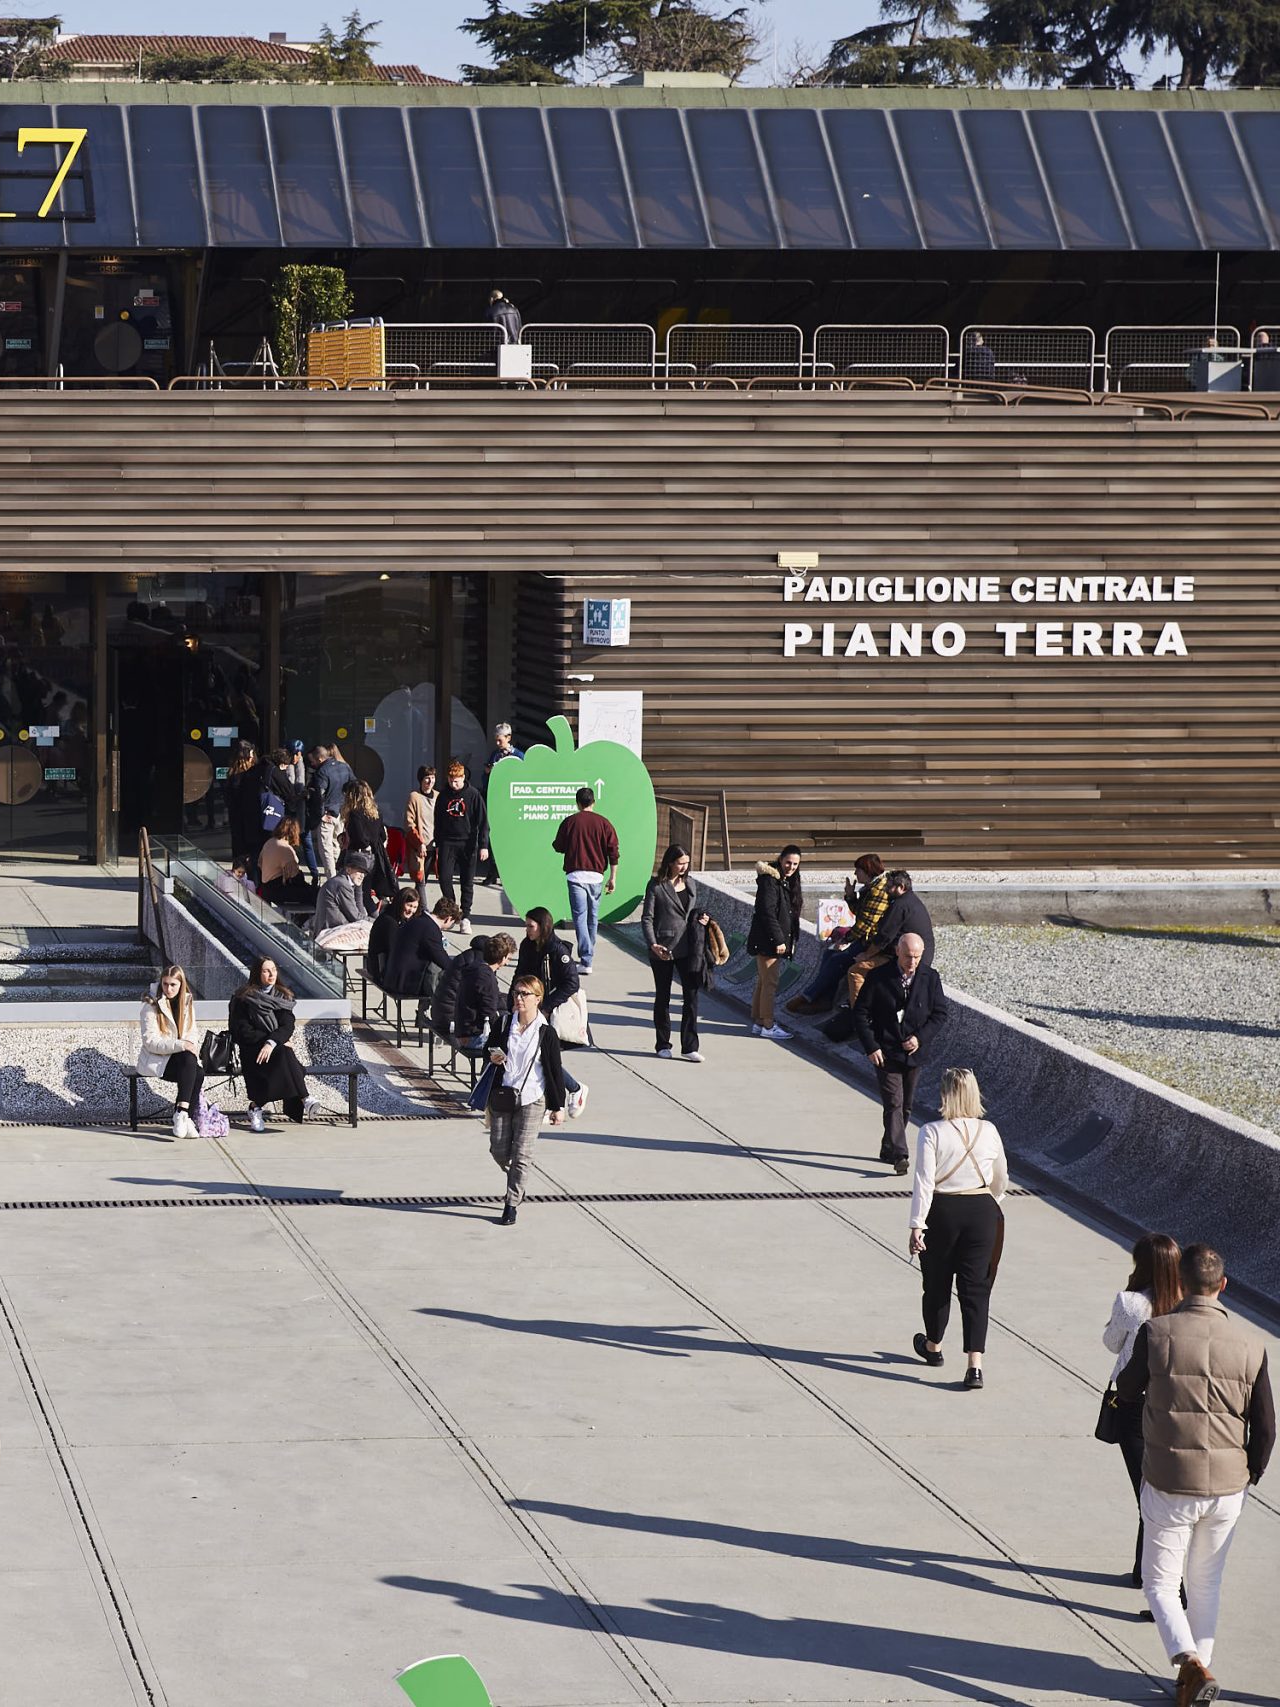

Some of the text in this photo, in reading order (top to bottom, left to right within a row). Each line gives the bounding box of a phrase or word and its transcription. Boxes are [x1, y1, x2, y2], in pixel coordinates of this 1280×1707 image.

[783, 576, 1195, 602] PADIGLIONE CENTRALE
[783, 622, 1188, 657] PIANO TERRA
[513, 786, 534, 794] PAD.
